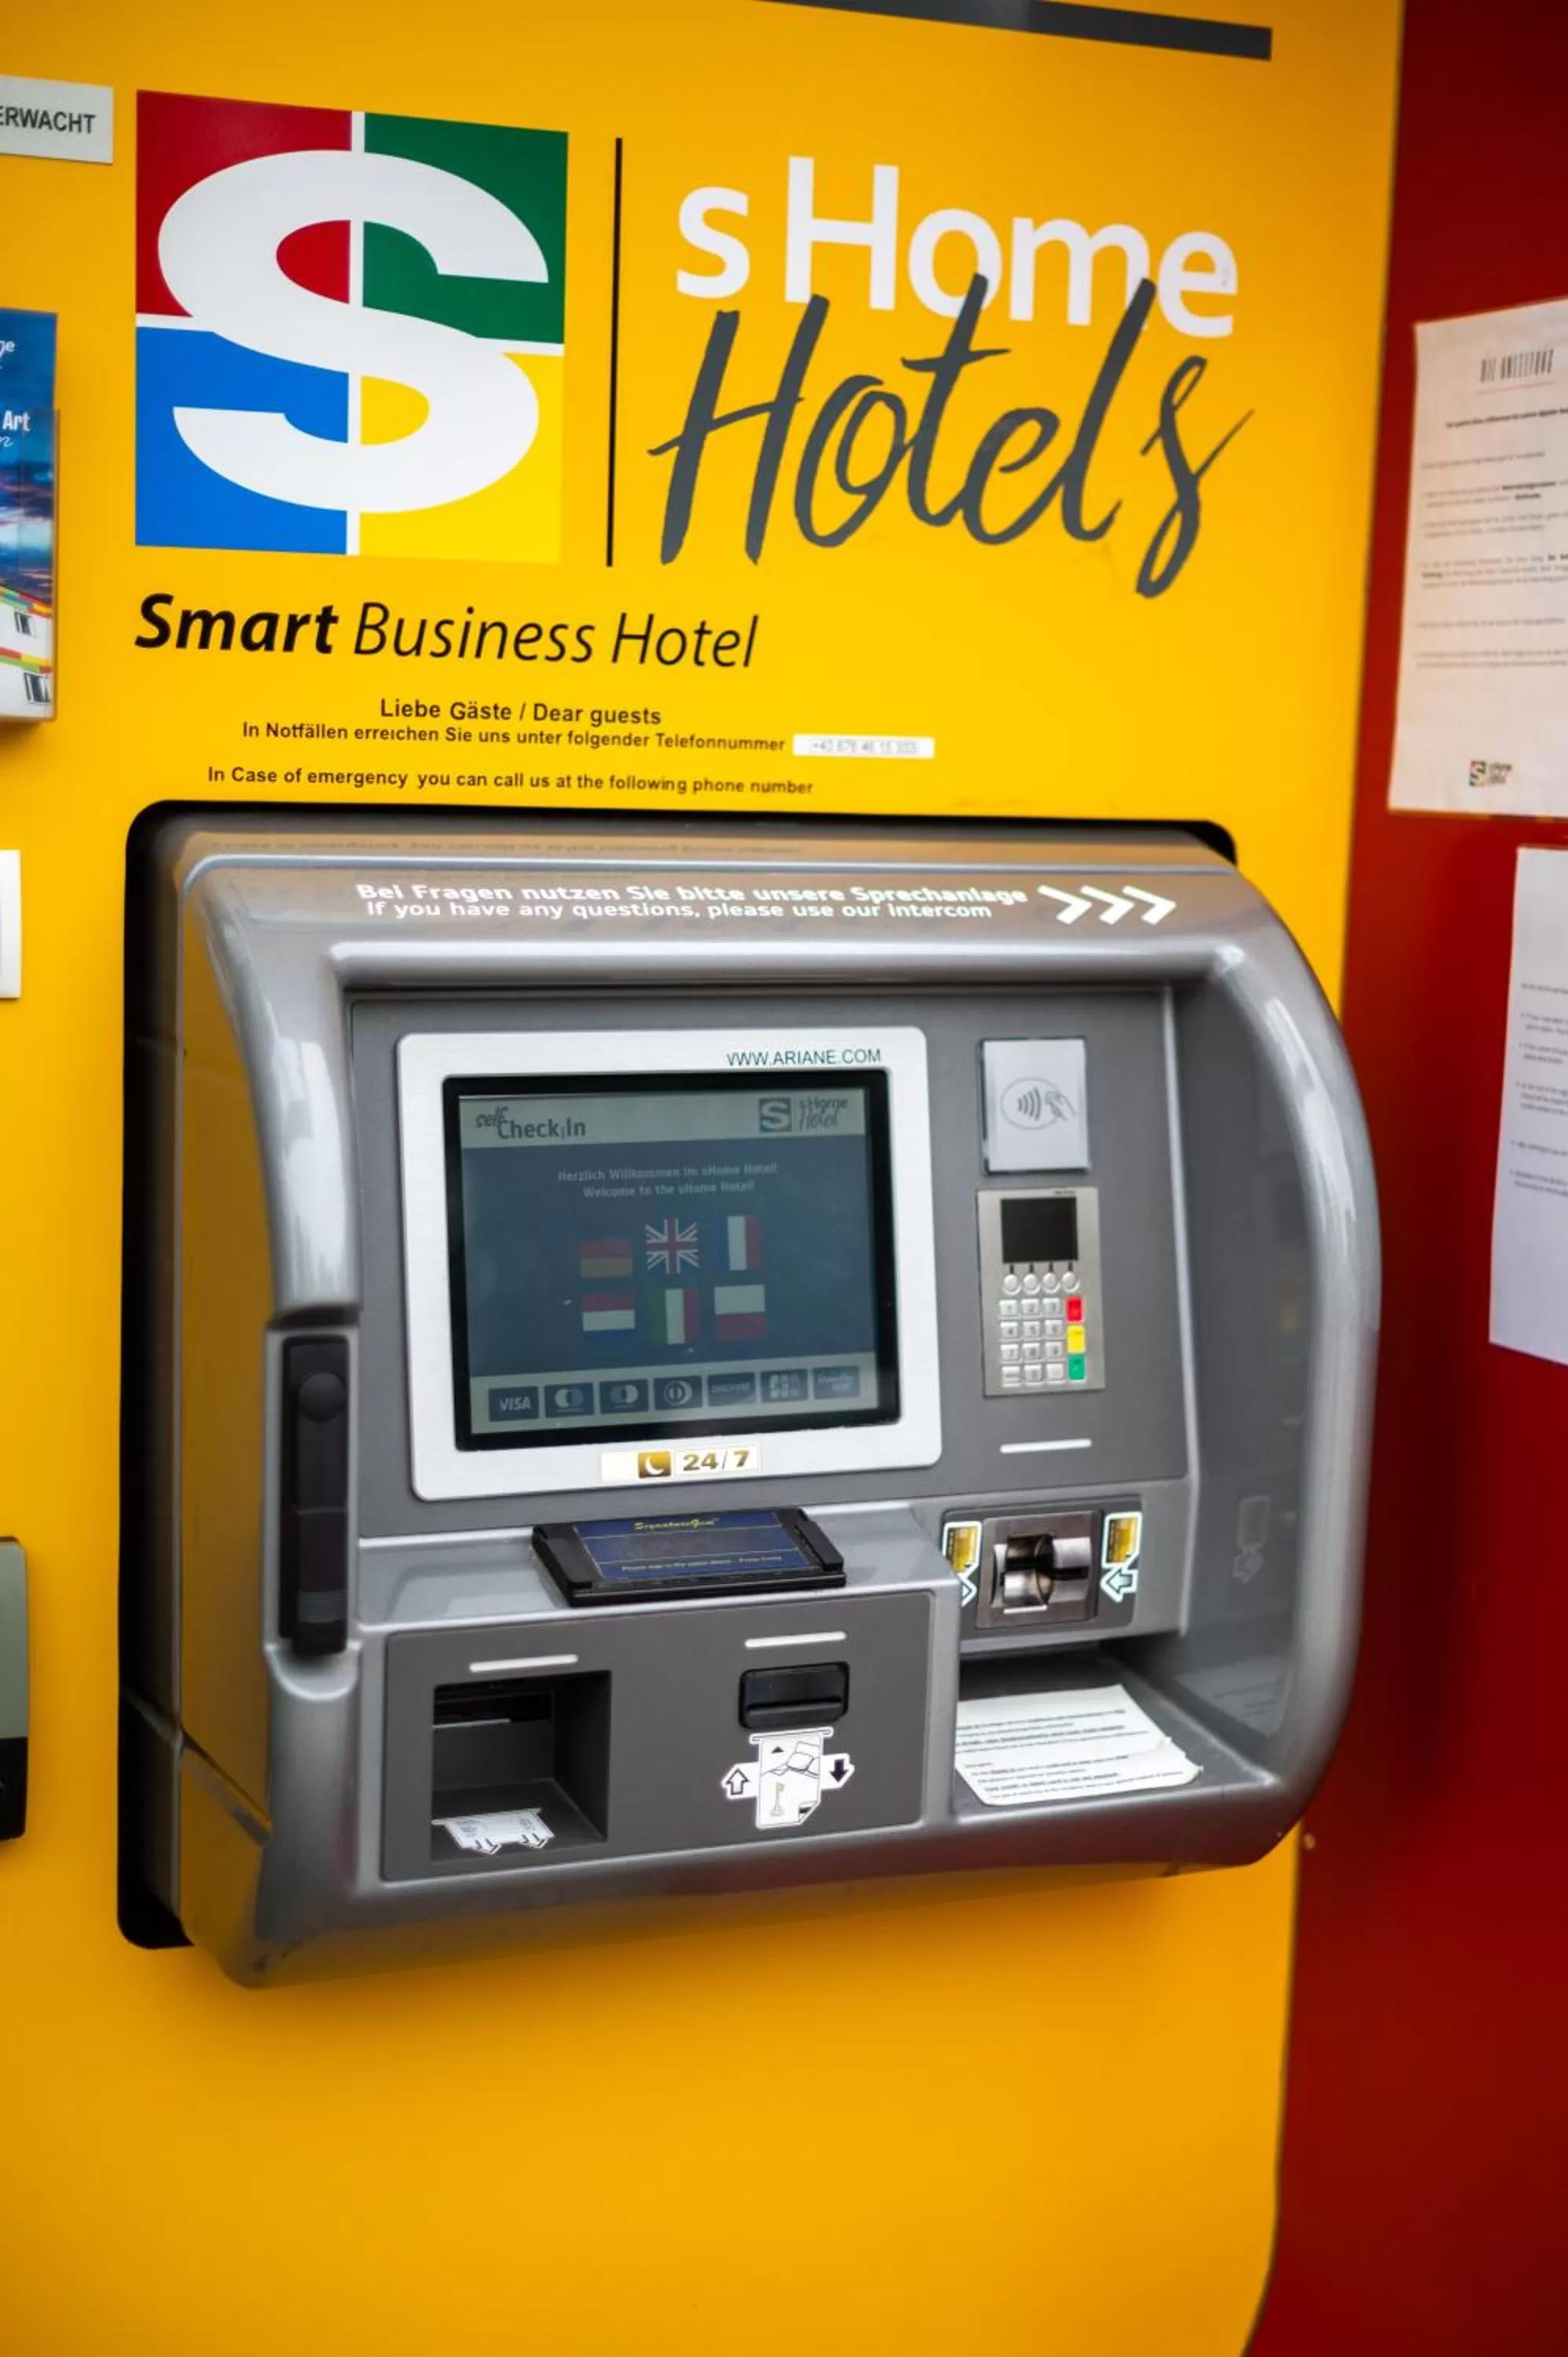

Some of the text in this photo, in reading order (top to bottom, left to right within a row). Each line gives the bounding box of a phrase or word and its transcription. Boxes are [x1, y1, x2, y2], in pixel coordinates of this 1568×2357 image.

[158, 149, 549, 513] S
[2, 410, 31, 431] Art
[647, 273, 1255, 599] Hotels
[135, 593, 758, 669] Smart Business Hotel
[380, 698, 661, 726] Liebe Gäste / Dear guests
[243, 722, 258, 737] In
[266, 723, 348, 739] Notfällen
[445, 727, 471, 742] Sie
[478, 731, 510, 743] uns
[517, 731, 562, 745] unter
[567, 731, 649, 750] folgender
[657, 732, 785, 752] Telefonnummer
[208, 767, 813, 795] In Case of emergency you can call us at the following phone number
[357, 884, 1028, 906] Bei Fragen nutzen Sie bitte unsere Sprechanlage
[368, 901, 383, 915] If
[394, 904, 441, 918] you
[451, 902, 510, 916] have
[519, 905, 562, 919] any
[709, 903, 782, 919] please
[793, 905, 833, 917] use
[842, 905, 881, 918] our
[726, 1049, 881, 1066] WWW.ARIANE.COM
[559, 1168, 605, 1182] Herzlich
[609, 1167, 680, 1180] Willkommen
[583, 1184, 636, 1198] Welcome
[639, 1183, 652, 1195] to
[655, 1182, 676, 1195] the
[499, 1395, 533, 1411] VISA
[683, 1449, 751, 1472] 24/7
